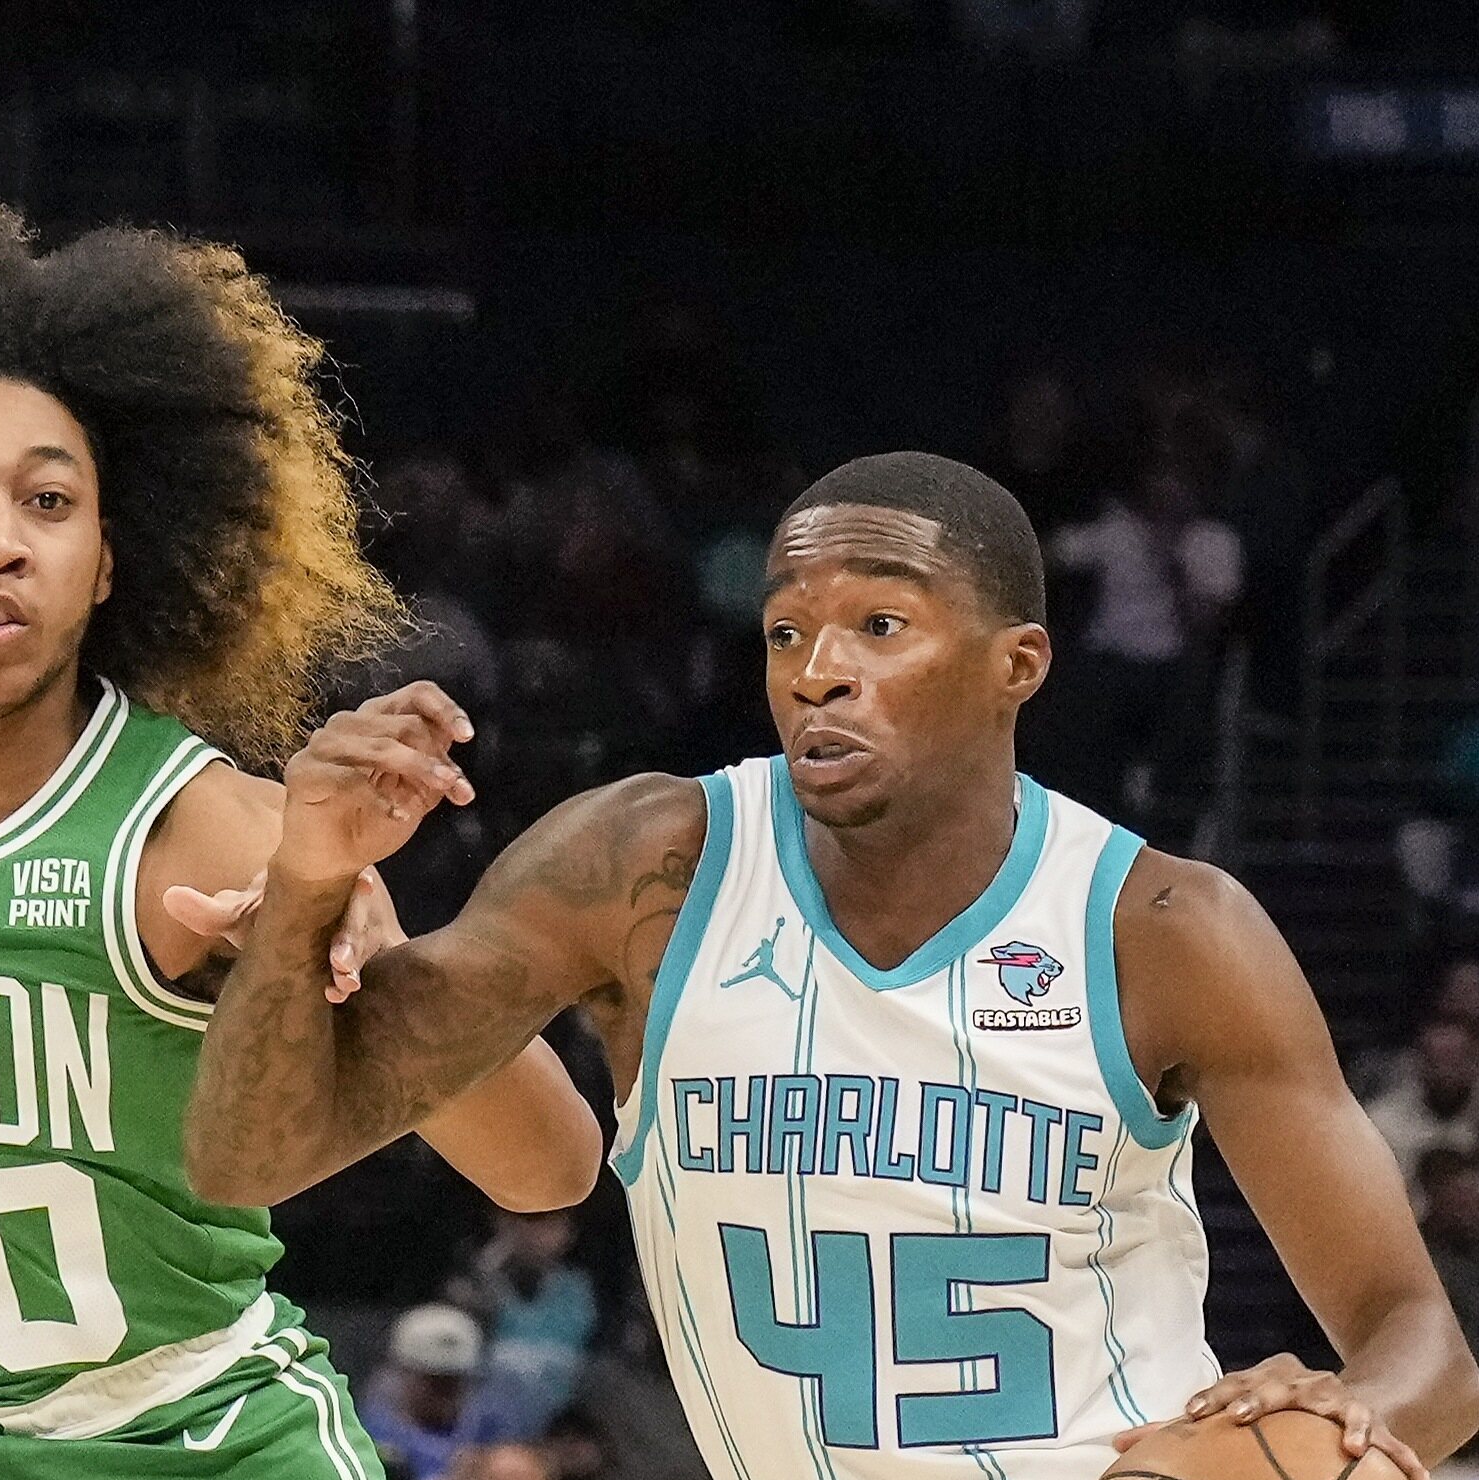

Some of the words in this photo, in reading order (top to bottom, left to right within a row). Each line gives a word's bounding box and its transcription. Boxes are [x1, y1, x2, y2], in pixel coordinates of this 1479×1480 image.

[13, 858, 91, 898] VISTA
[8, 899, 91, 928] PRINT
[973, 1007, 1082, 1031] FEASTABLES
[671, 1074, 1104, 1207] CHARLOTTE
[717, 1222, 1059, 1451] 45
